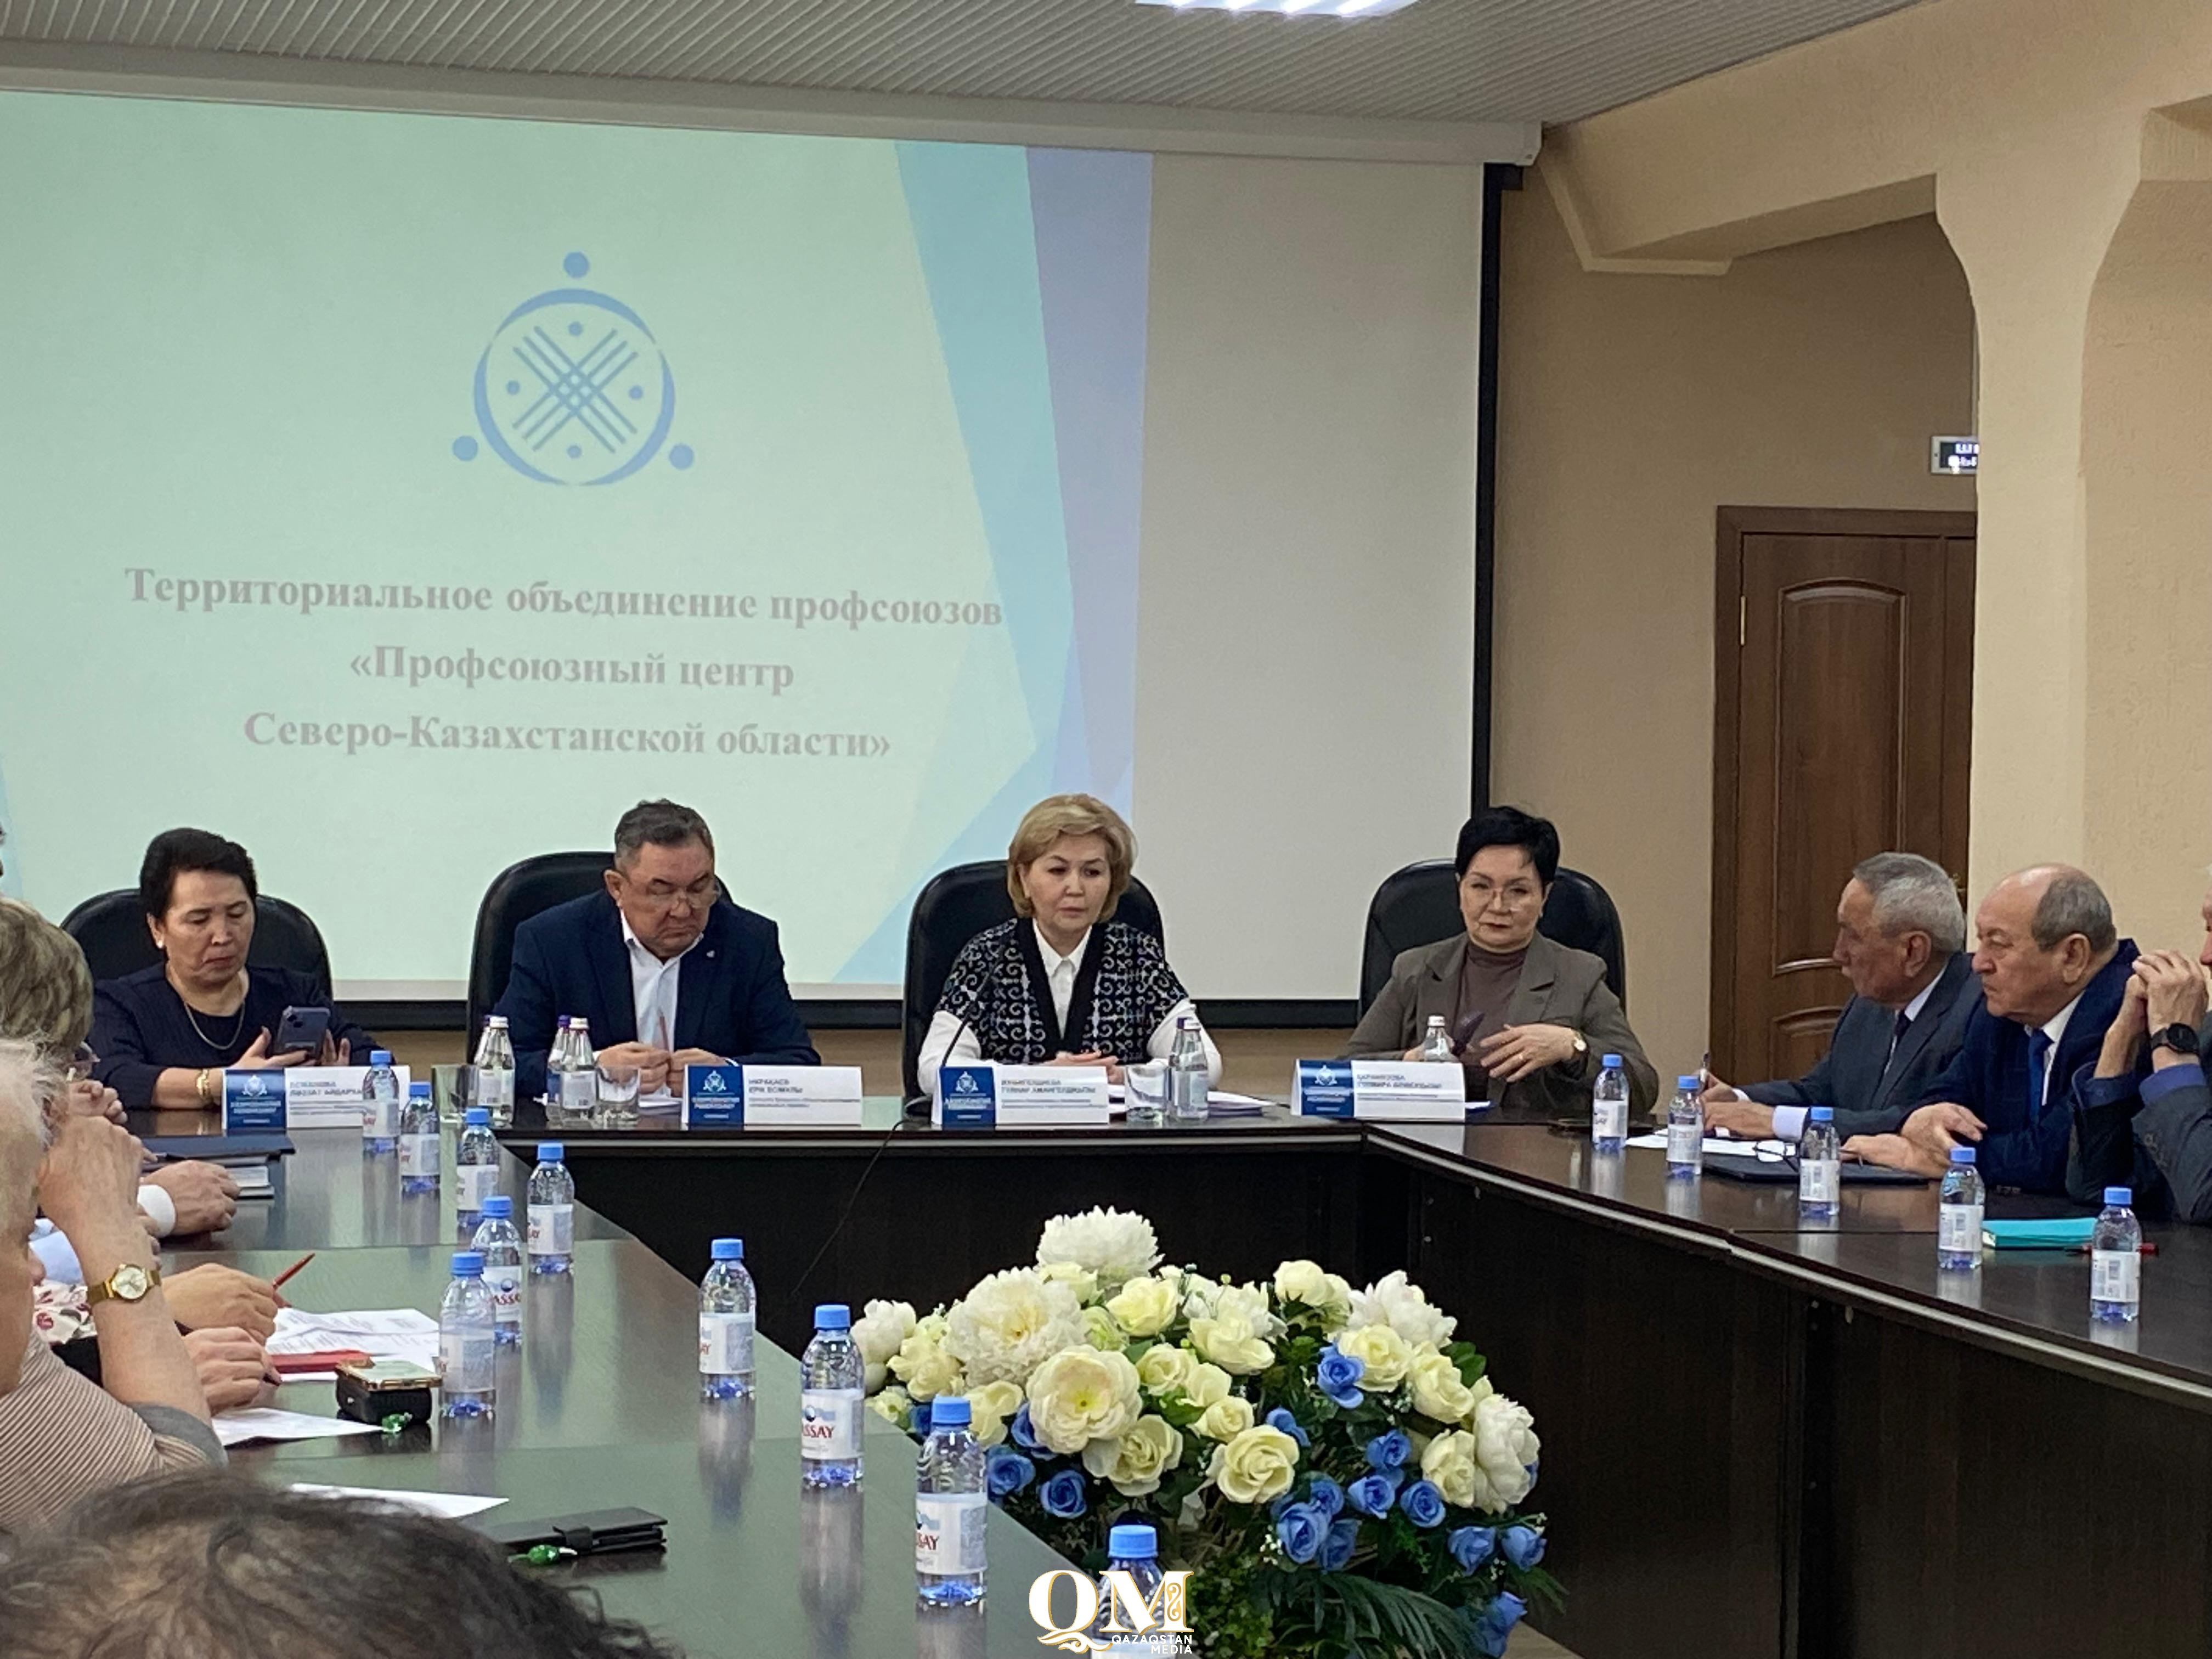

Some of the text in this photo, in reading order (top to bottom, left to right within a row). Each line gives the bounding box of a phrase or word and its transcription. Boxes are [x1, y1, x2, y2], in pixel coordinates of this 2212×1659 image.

[125, 568, 1001, 630] Территориальное объединение профсоюзов
[351, 646, 794, 696] «Профсоюзный центр
[244, 713, 890, 756] Северо-Казахстанской области»
